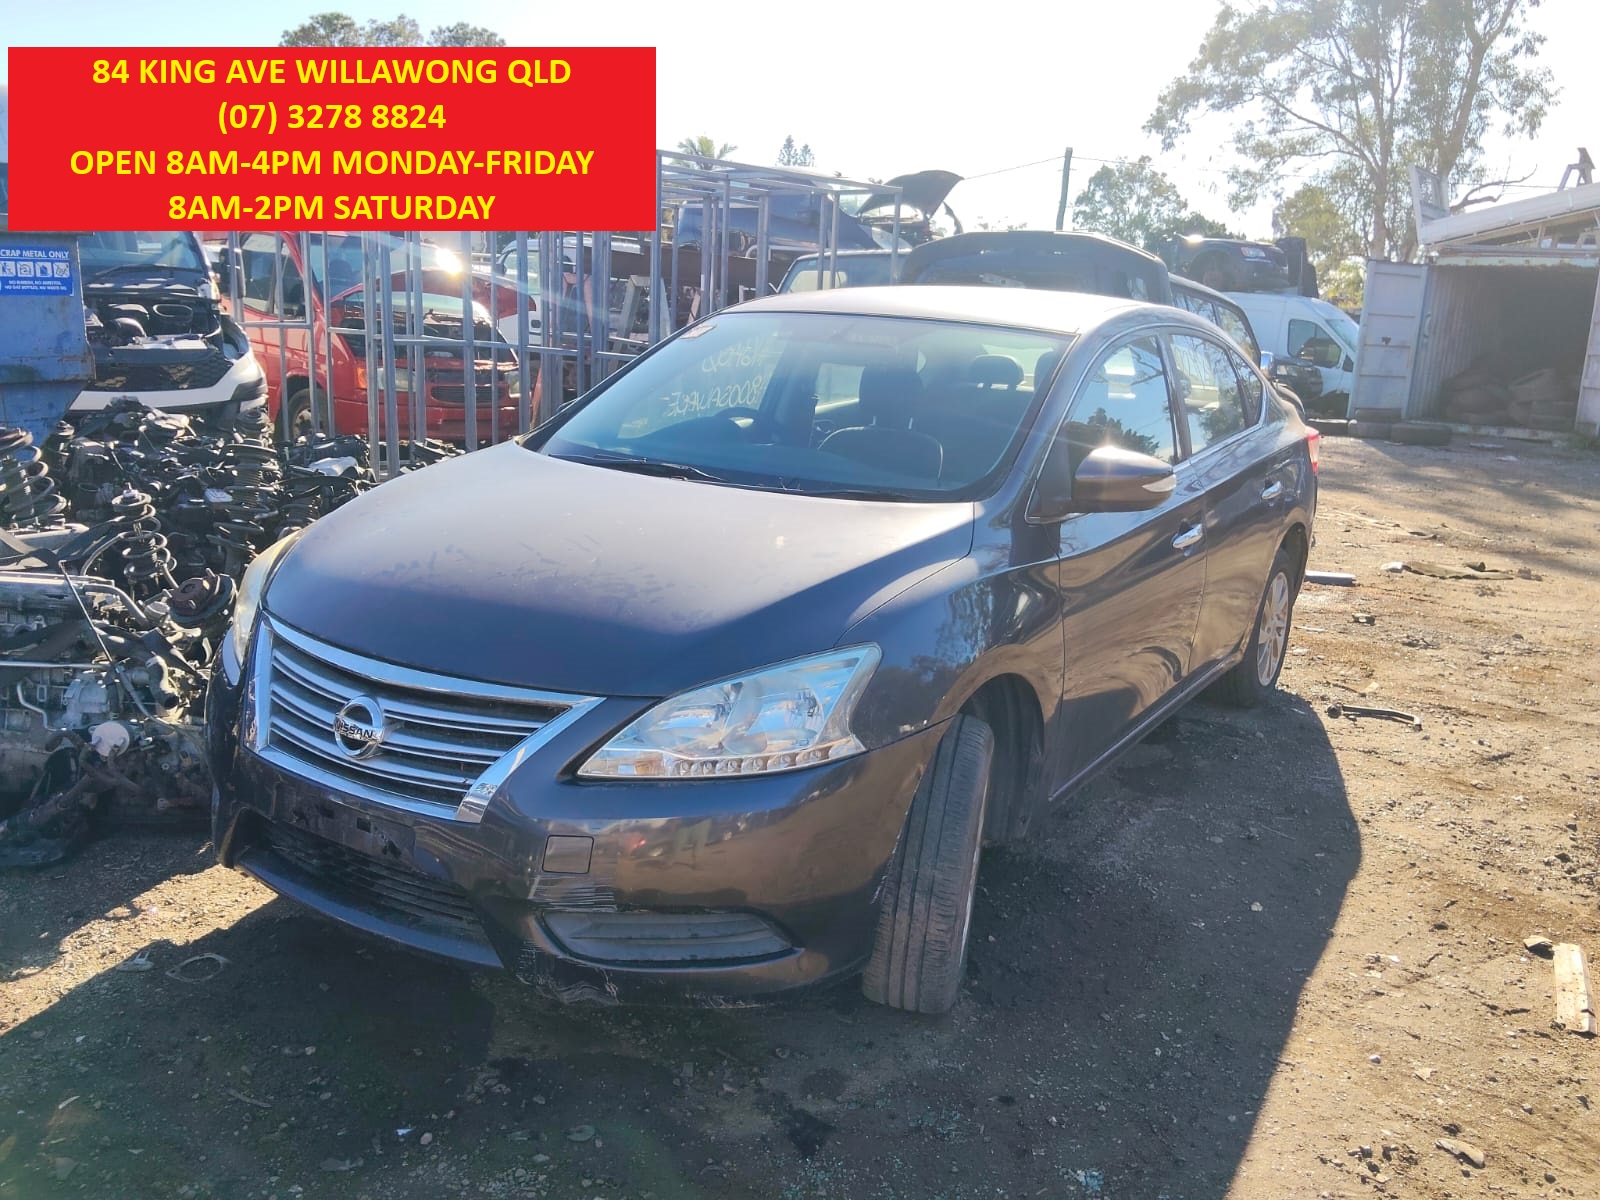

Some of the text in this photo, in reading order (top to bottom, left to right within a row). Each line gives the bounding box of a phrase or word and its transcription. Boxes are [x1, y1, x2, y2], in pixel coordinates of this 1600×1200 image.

[0, 249, 69, 259] CRAP METAL ONLY
[334, 717, 374, 740] NISSAN
